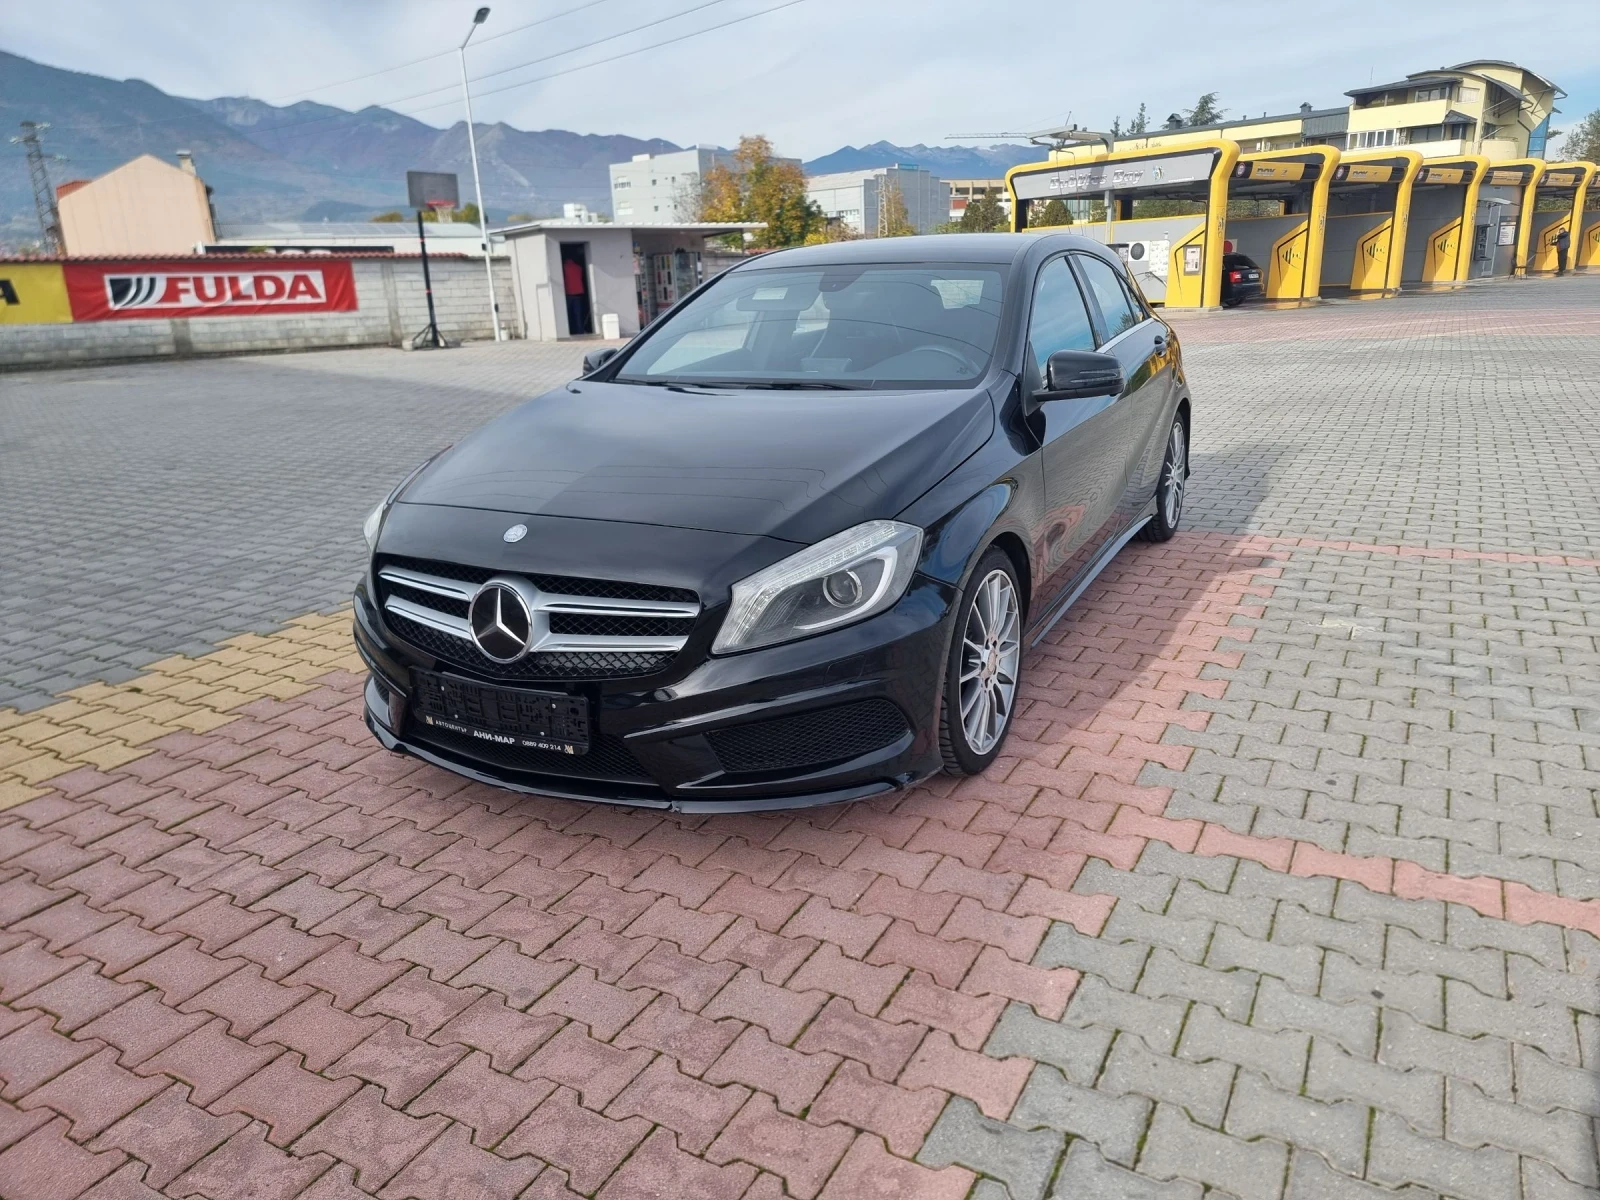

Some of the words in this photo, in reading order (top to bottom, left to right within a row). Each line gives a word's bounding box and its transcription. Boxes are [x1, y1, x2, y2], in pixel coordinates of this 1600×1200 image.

[1112, 169, 1144, 185] Bay
[157, 274, 322, 303] FULDA
[473, 730, 515, 744] АНИ-МАР
